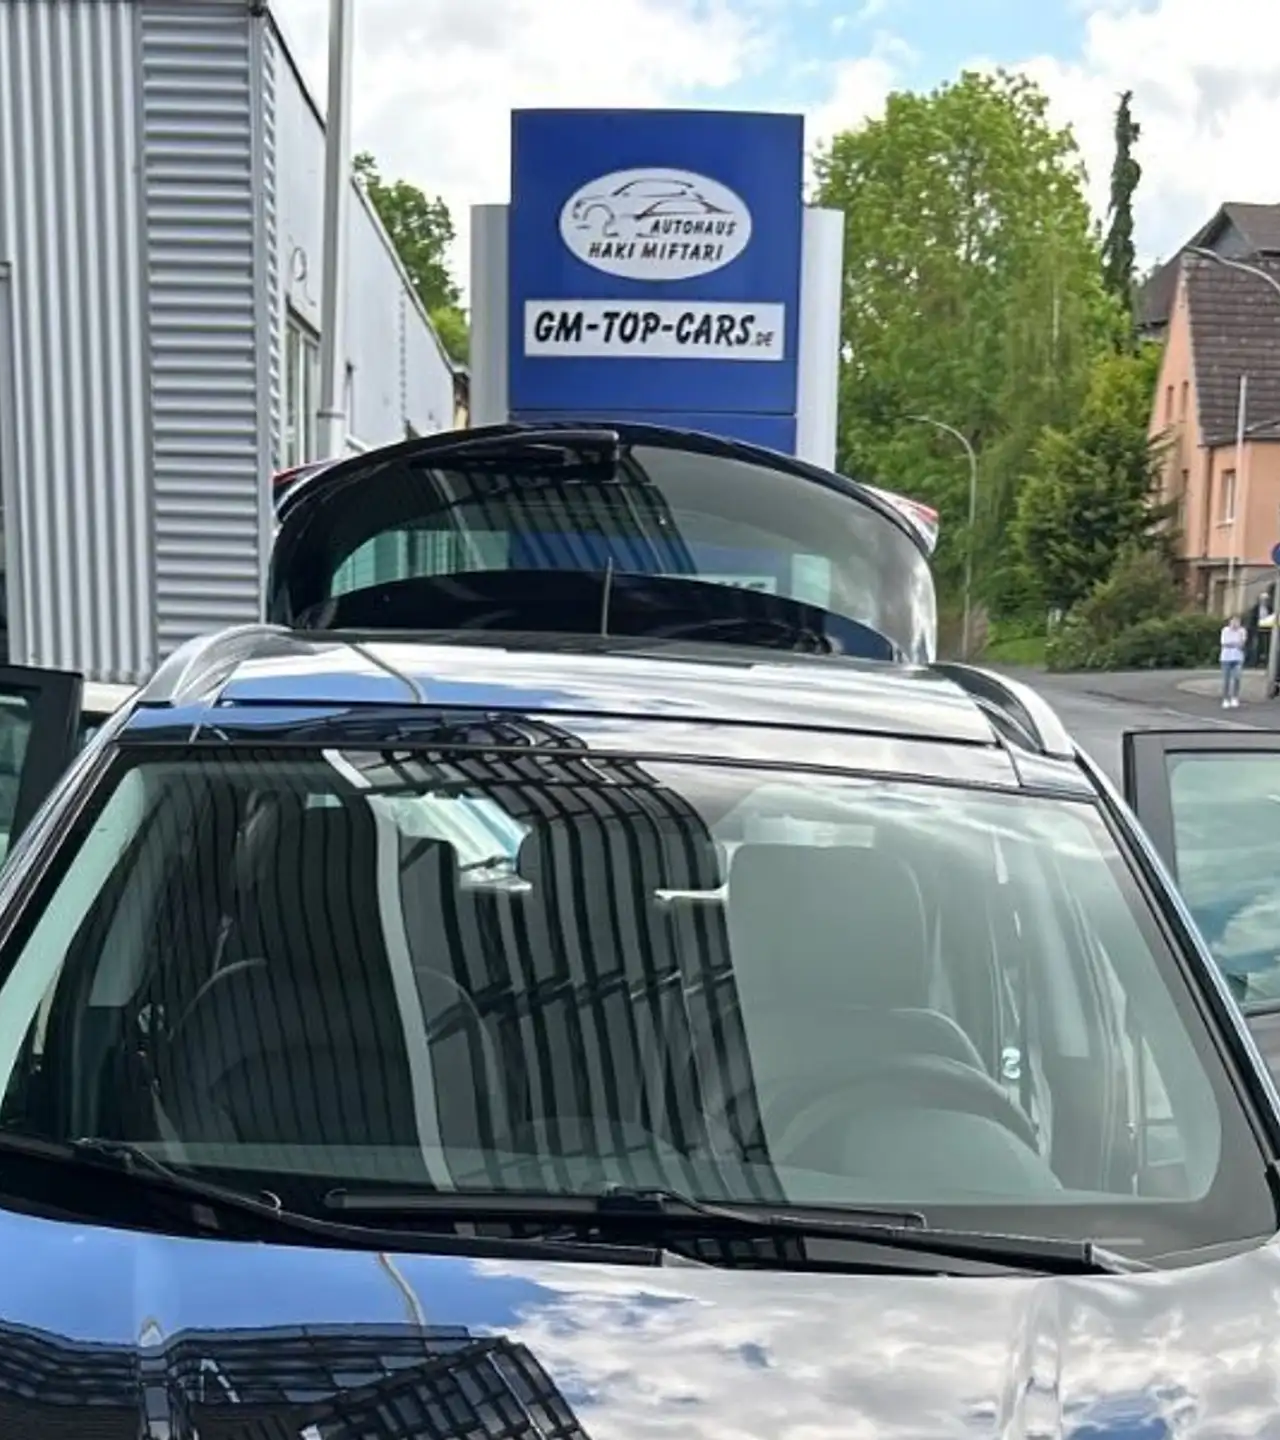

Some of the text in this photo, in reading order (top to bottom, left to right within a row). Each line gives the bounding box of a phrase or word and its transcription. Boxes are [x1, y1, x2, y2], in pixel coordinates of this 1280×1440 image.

[649, 218, 737, 237] AUTOHAUS
[587, 241, 724, 262] HAKI MIFTARI
